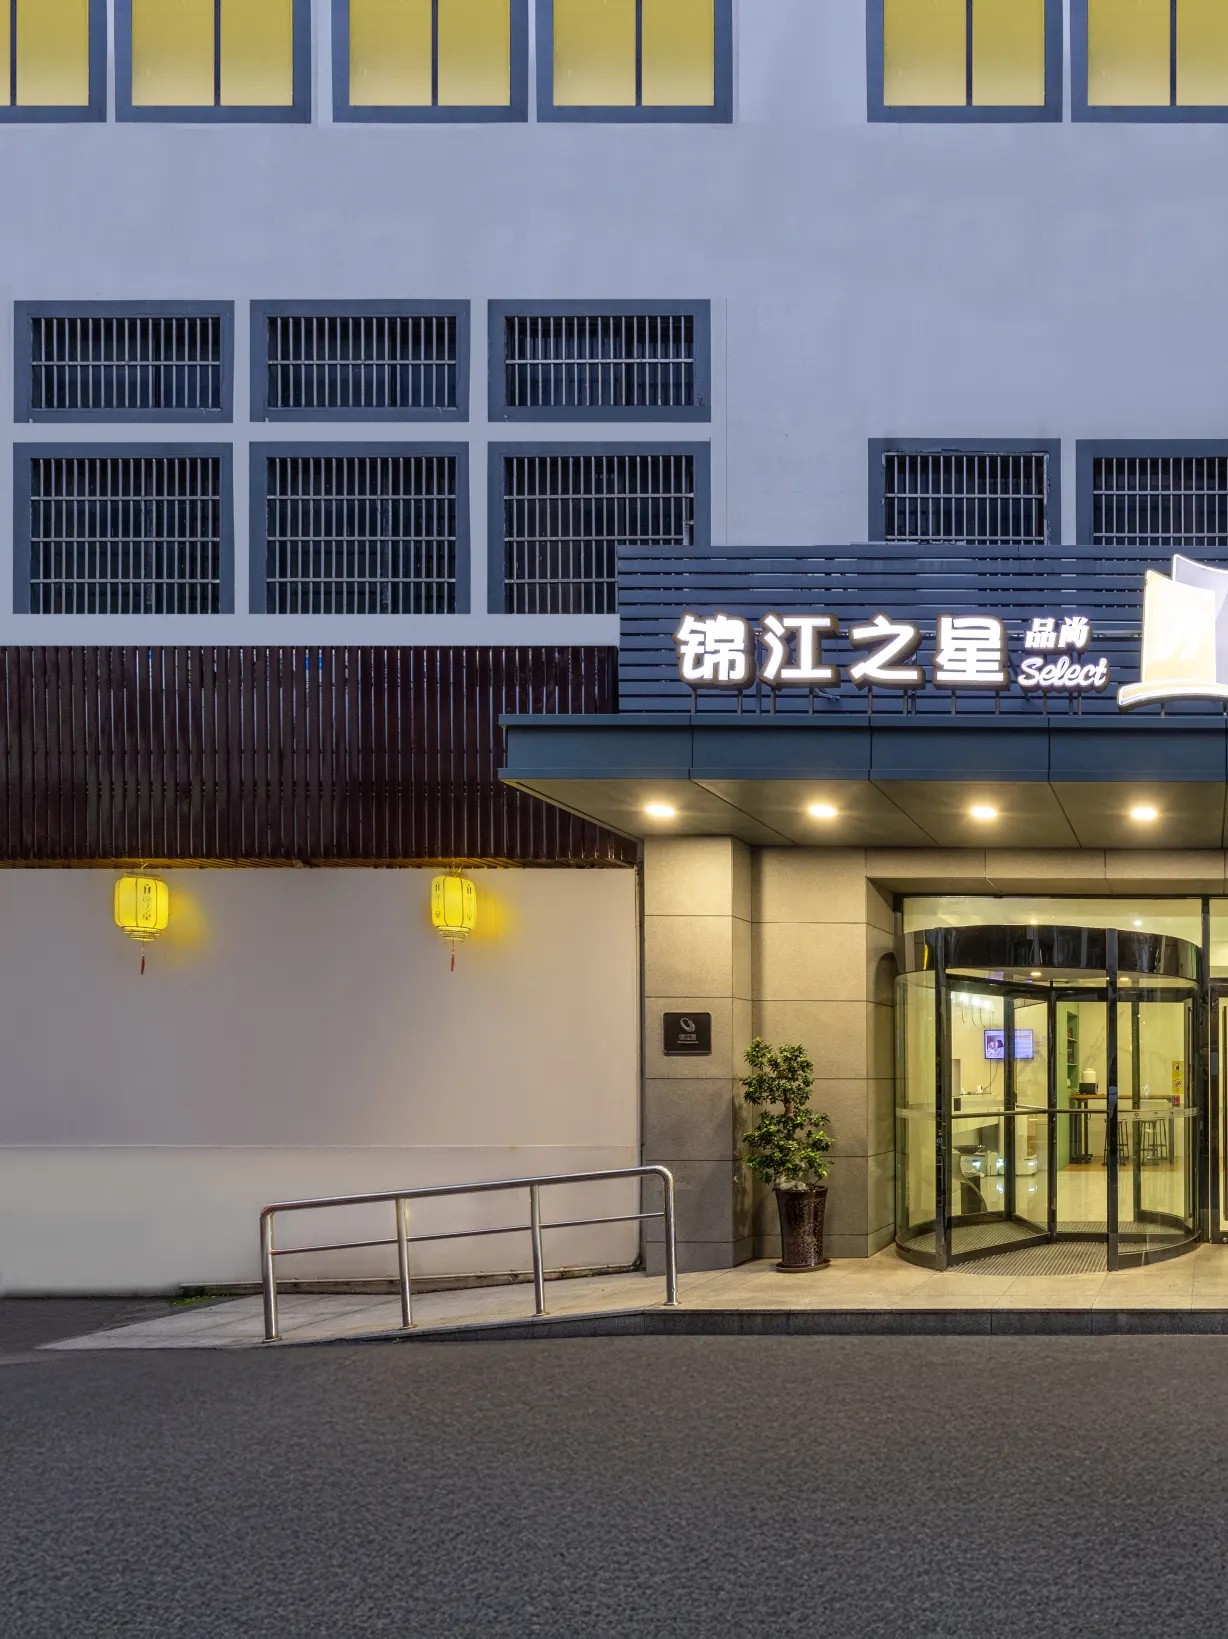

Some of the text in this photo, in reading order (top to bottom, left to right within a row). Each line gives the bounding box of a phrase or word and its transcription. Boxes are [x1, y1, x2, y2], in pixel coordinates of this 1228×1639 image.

[676, 614, 1004, 682] 锦江之星
[1023, 615, 1090, 649] 品尚
[1017, 655, 1108, 687] Select
